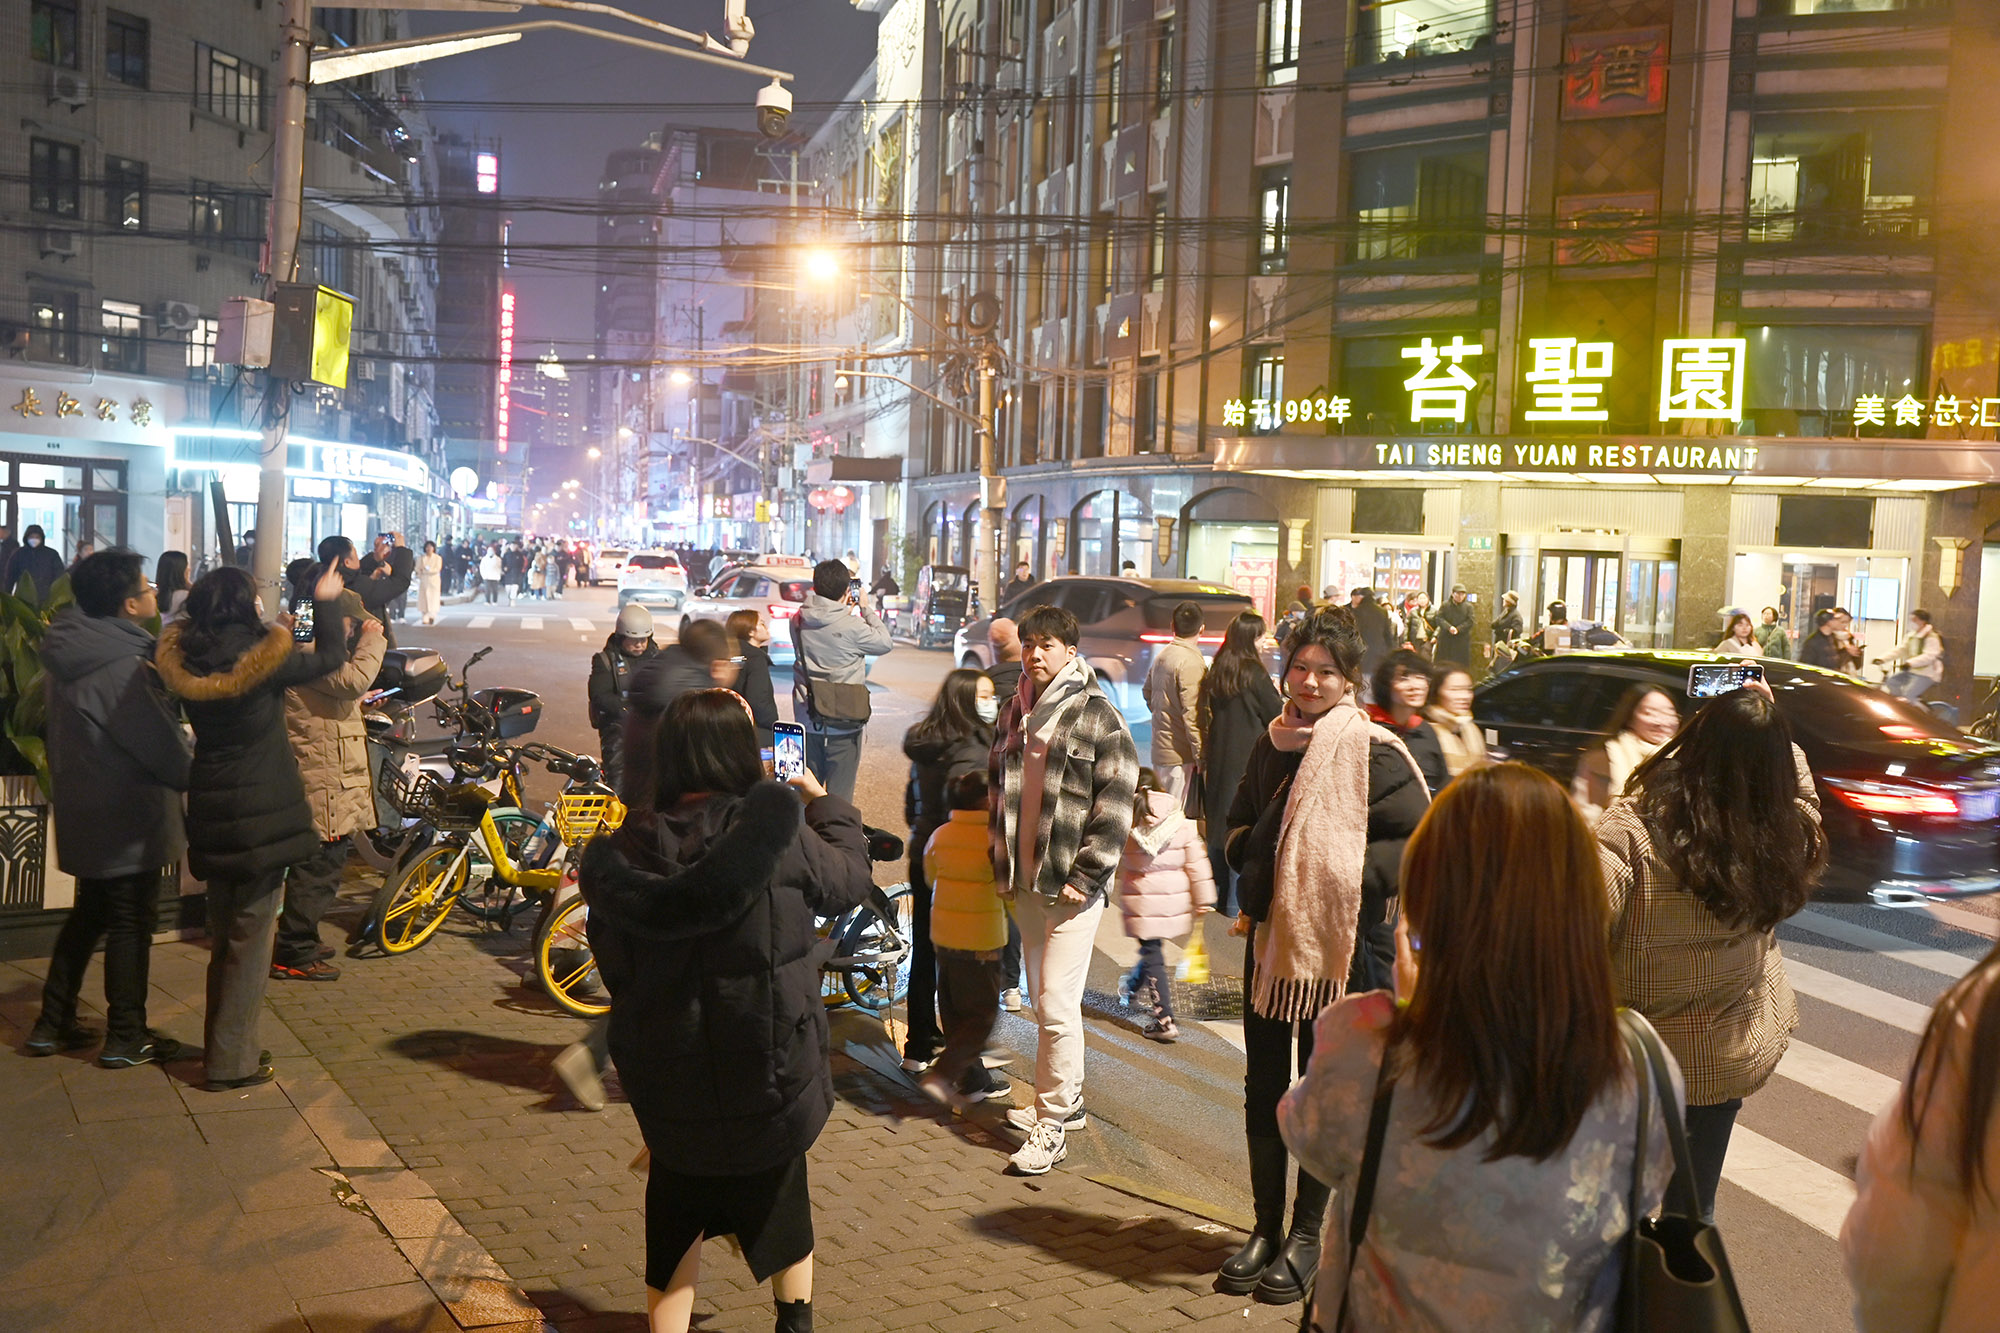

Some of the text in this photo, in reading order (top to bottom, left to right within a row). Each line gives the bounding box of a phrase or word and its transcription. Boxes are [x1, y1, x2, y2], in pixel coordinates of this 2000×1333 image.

[1401, 336, 1747, 423] 苔聖園
[1222, 394, 1352, 427] 始于1993年
[1853, 393, 2000, 427] 美食总汇
[1375, 443, 1760, 470] TAI SHENG YUAN RESTAURANT
